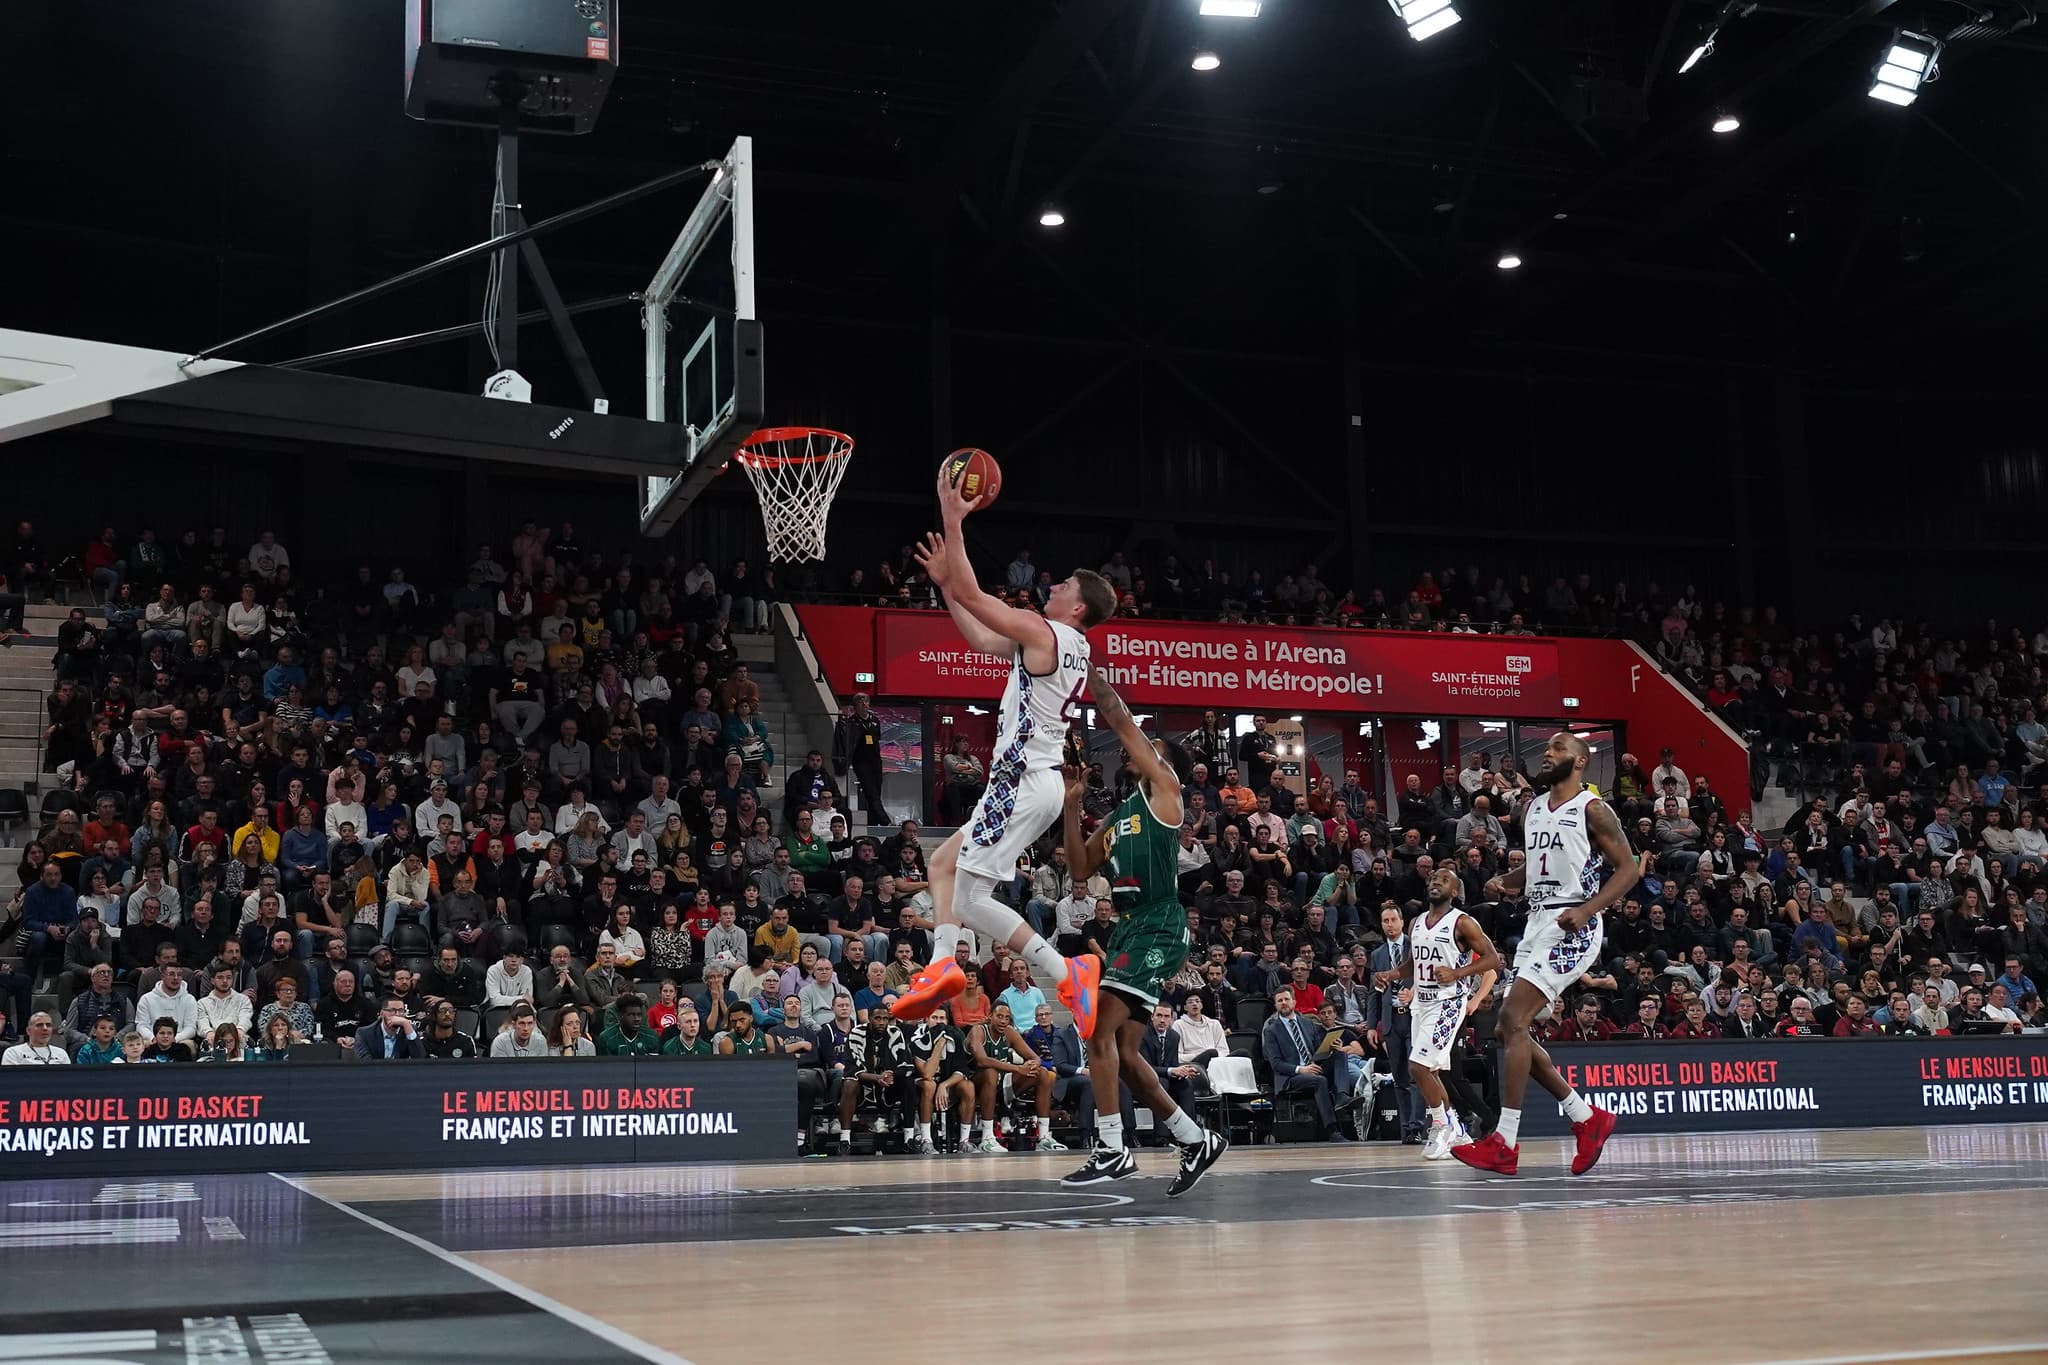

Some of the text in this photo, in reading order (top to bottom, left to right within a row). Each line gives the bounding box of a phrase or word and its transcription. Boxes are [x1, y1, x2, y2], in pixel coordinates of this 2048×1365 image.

[549, 417, 574, 439] Sports
[965, 473, 980, 495] LNB
[919, 650, 1012, 665] SAINT-ÉTIEN
[1107, 634, 1346, 664] Bienvenue à l'Arena
[937, 664, 1010, 679] la métropo
[1095, 660, 1383, 697] aint-Étienne Métropole !
[1432, 671, 1520, 685] SAINT-ÉTIENNE
[1631, 664, 1641, 693] F
[1060, 677, 1085, 722] 6
[1448, 685, 1520, 699] la métropole
[1528, 832, 1564, 850] JDA
[1539, 853, 1550, 876] 1
[1414, 946, 1443, 962] JDA
[1418, 963, 1437, 982] 11
[1585, 1063, 1674, 1087] MENSUEL
[1679, 1062, 1704, 1085] DU
[1711, 1061, 1778, 1084] BASKET
[1920, 1058, 1941, 1079] LE
[1946, 1056, 2026, 1078] MENSUEL
[442, 1087, 695, 1114] LE MENSUEL DU BASKET
[1653, 1090, 1675, 1114] ET
[1682, 1088, 1819, 1113] INTERNATIONAL
[1922, 1083, 2003, 1111] FRANÇAIS
[2008, 1082, 2028, 1104] ET
[0, 1096, 263, 1123] E MENSUEL DU BASKET
[0, 1122, 310, 1156] RANÇAIS ET INTERNATIONAL
[442, 1112, 739, 1145] FRANÇAIS ET INTERNATIONAL
